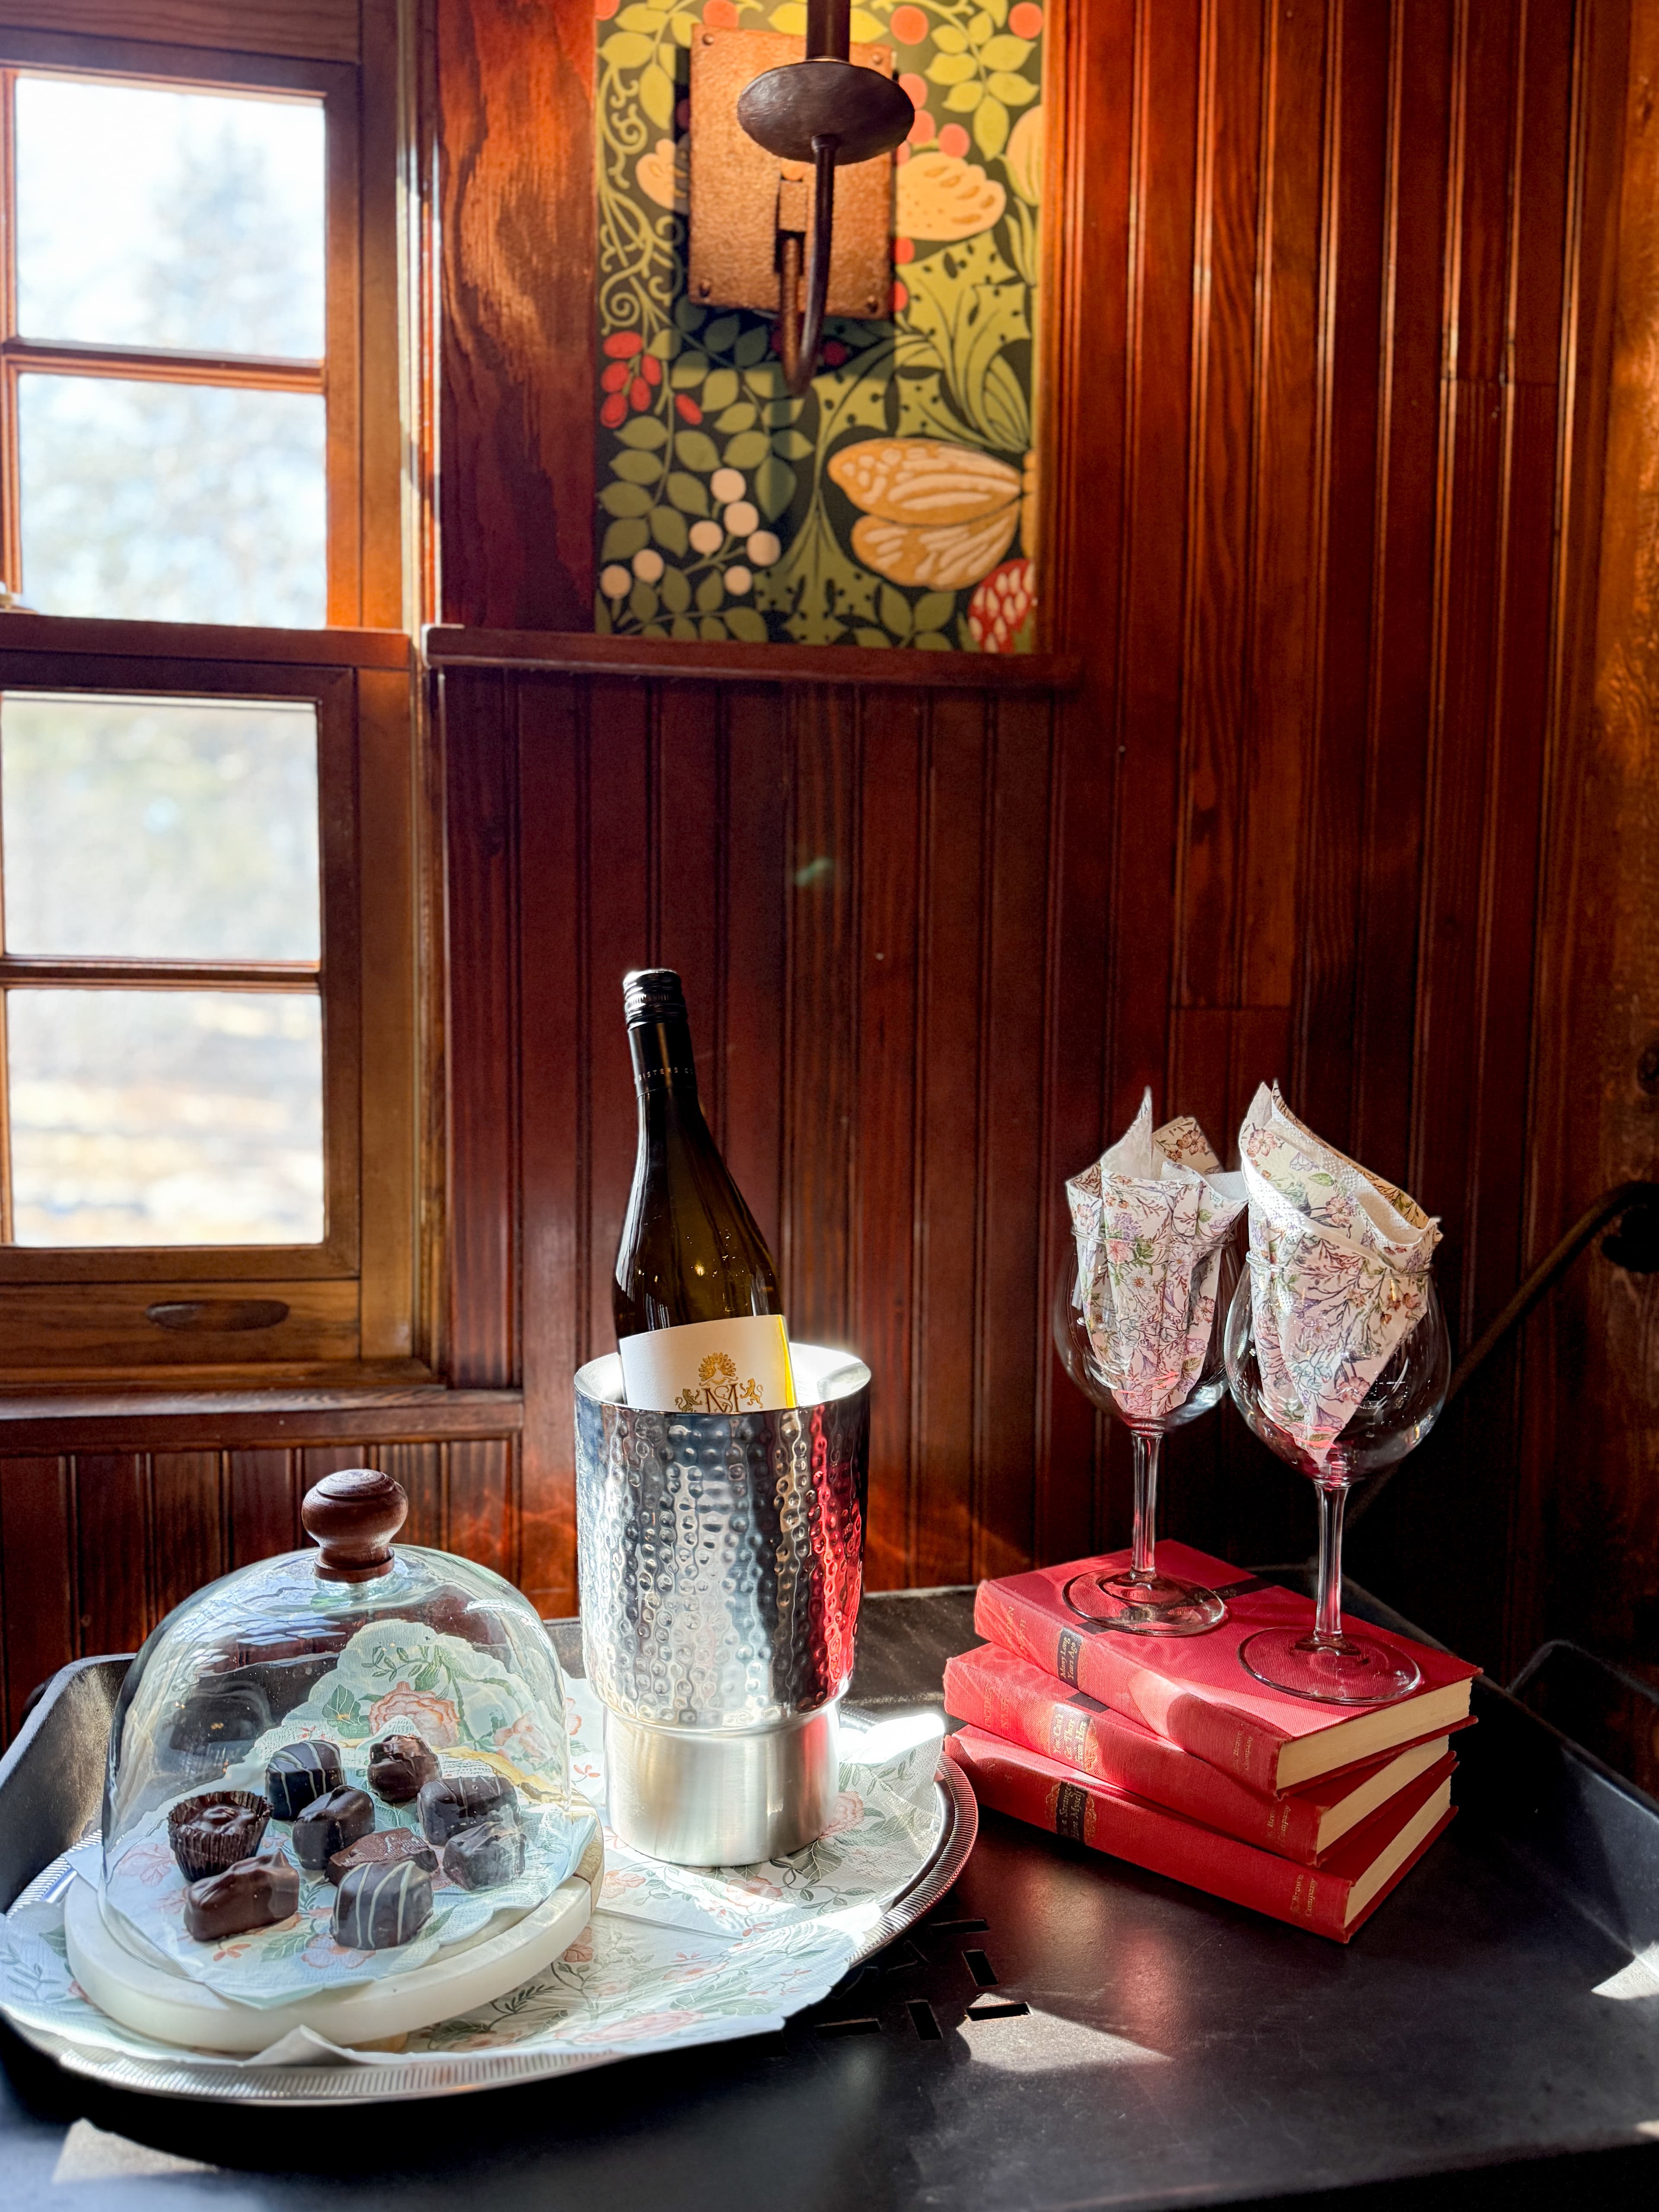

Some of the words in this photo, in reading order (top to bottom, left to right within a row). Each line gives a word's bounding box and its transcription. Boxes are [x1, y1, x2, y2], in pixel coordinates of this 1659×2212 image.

[639, 1067, 678, 1081] SISTERS
[1060, 1637, 1071, 1656] Long
[1068, 1642, 1077, 1659] Ago
[1053, 1713, 1064, 1736] Can't
[1075, 1721, 1087, 1742] Here
[1075, 1744, 1084, 1765] From
[1244, 1735, 1253, 1770] Company
[1071, 1789, 1085, 1819] Myself
[1305, 1878, 1317, 1917] Company
